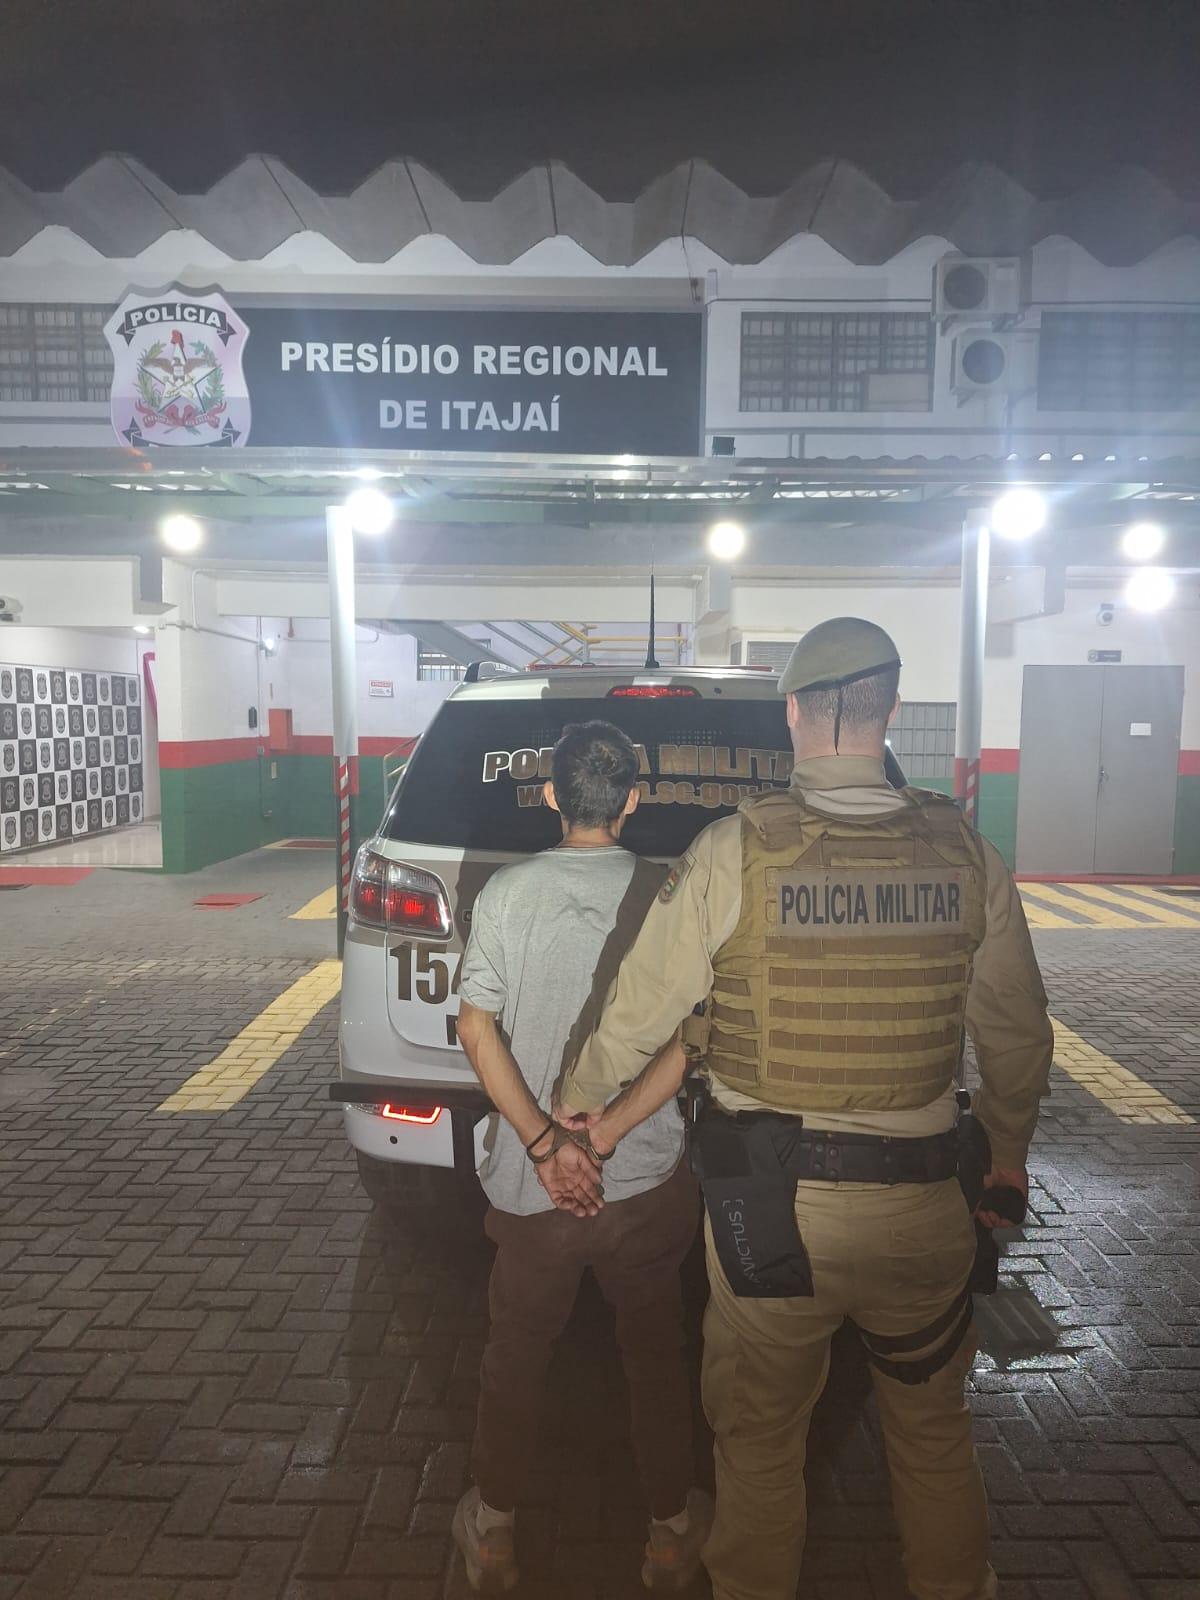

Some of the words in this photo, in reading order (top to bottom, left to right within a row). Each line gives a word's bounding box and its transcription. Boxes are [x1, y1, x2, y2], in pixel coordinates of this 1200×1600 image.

[130, 303, 222, 328] POLÍCIA
[281, 336, 460, 374] PRESÍDIO
[473, 345, 668, 376] REGIONAL
[379, 399, 427, 429] DE
[441, 395, 560, 431] ITAJAÍ
[659, 744, 795, 781] MILITA
[781, 875, 870, 925] POLÍCIA
[875, 883, 960, 923] MILITAR
